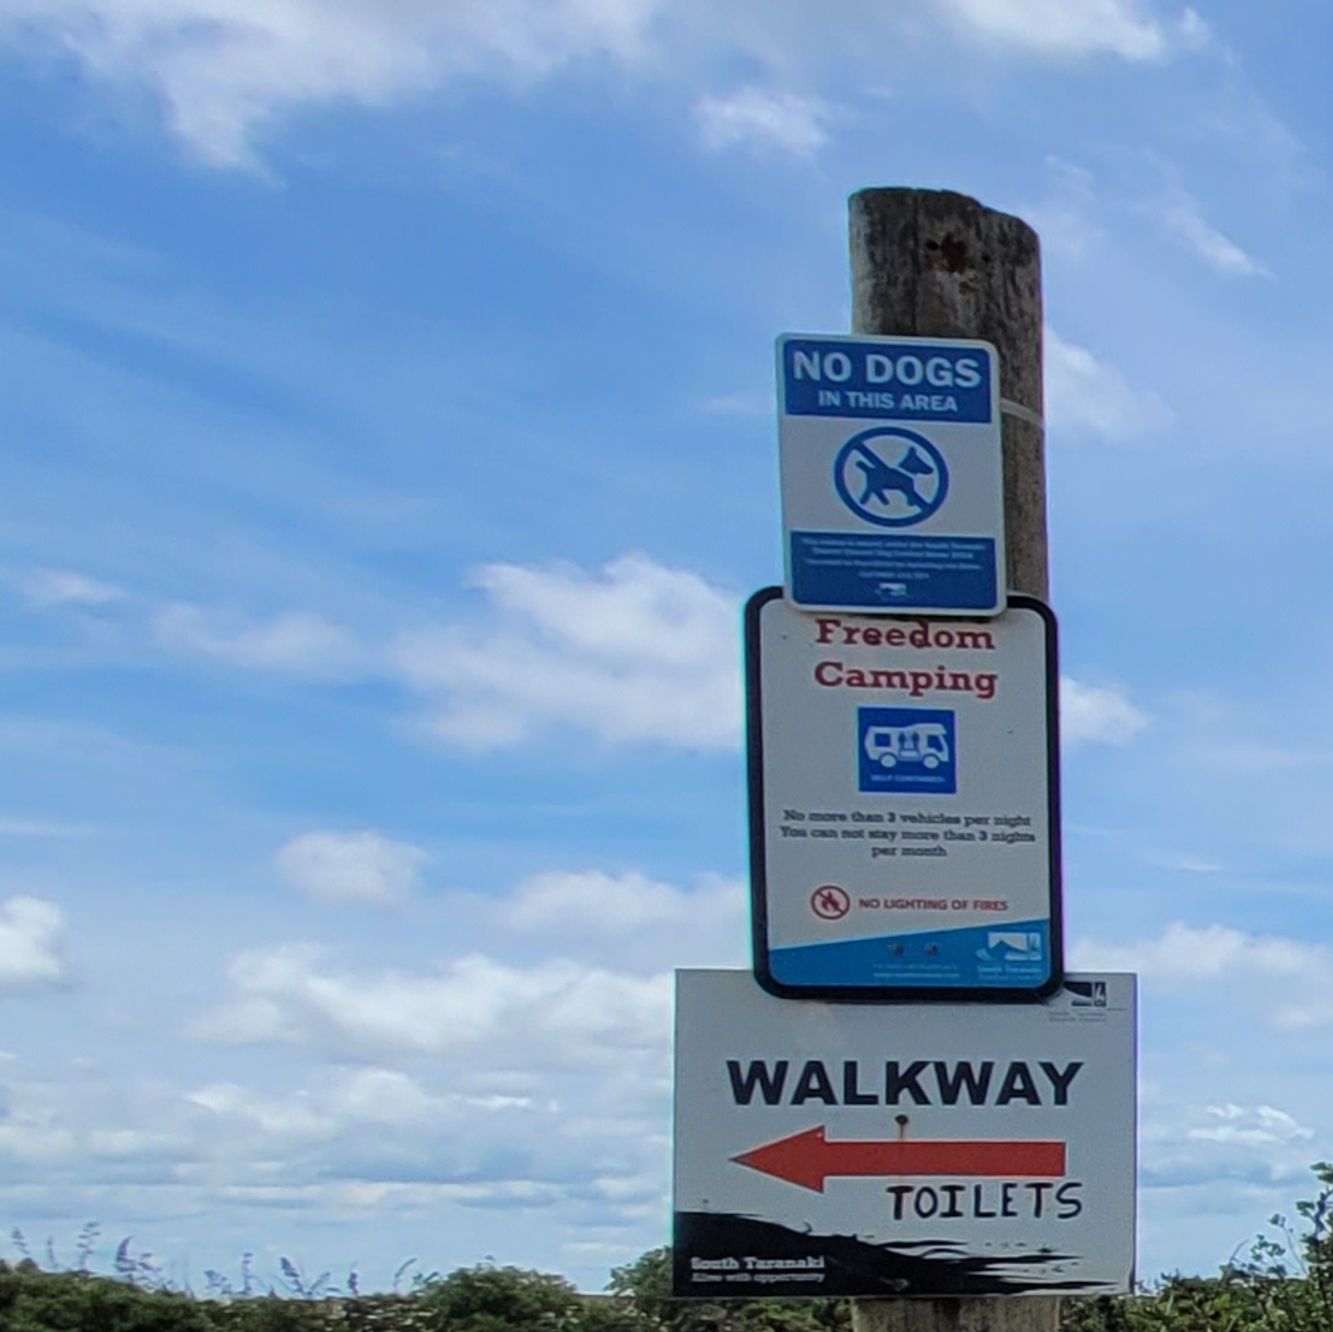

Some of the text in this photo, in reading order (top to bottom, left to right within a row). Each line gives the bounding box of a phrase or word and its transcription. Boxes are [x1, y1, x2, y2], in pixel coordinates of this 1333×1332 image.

[793, 351, 981, 388] NO DOGS
[818, 390, 958, 412] IN THIS AREA
[815, 618, 996, 650] Freedom
[814, 661, 998, 699] Camping
[783, 809, 805, 822] No
[809, 813, 847, 823] more
[850, 810, 884, 823] than
[900, 812, 961, 826] vehicles
[964, 815, 990, 827] per
[994, 815, 1031, 828] night
[780, 826, 807, 839] You
[810, 829, 838, 839] can
[841, 827, 865, 839] not
[868, 829, 898, 842] stay
[901, 830, 939, 841] more
[943, 829, 975, 842] than
[991, 831, 1036, 844] nights
[872, 845, 947, 858] per month
[859, 899, 1008, 911] NO LIGHTING OF FIRES
[726, 1060, 1085, 1106] WALKWAY
[887, 1182, 1083, 1220] TOILETS
[691, 1255, 825, 1270] South Taranaki
